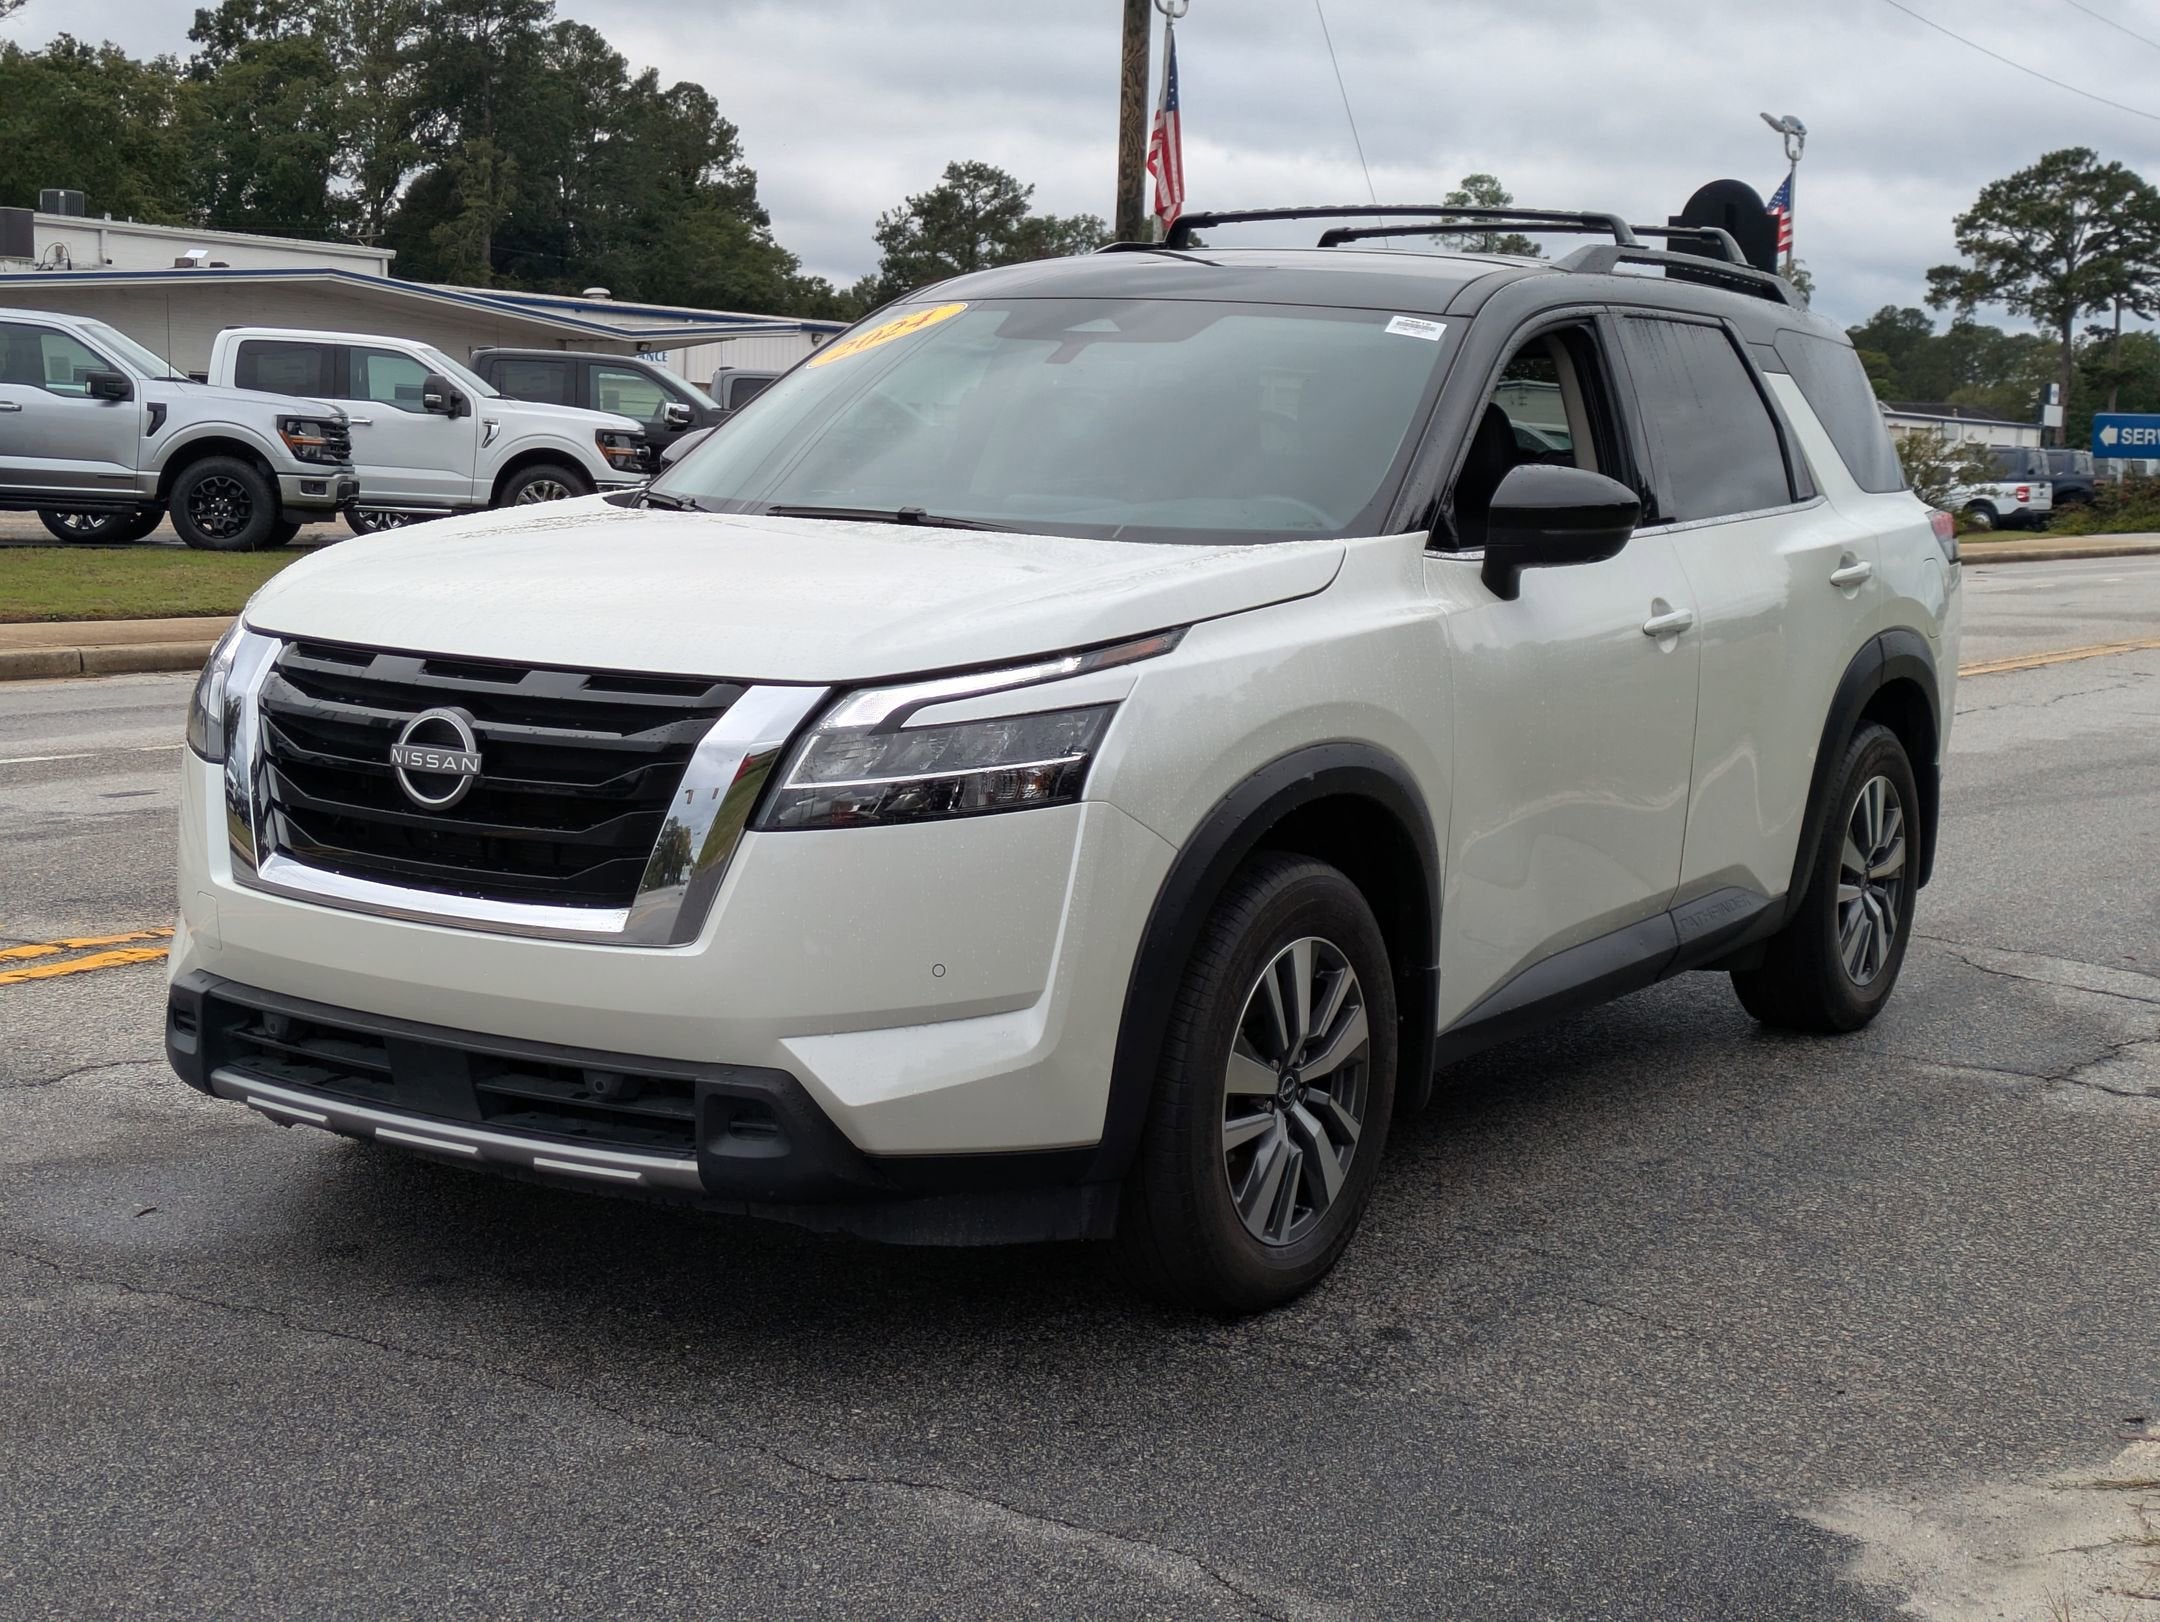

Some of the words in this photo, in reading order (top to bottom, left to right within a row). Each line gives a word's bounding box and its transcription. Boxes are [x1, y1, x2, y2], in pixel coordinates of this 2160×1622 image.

[827, 308, 939, 362] 2024
[2120, 427, 2160, 445] SER
[391, 748, 479, 772] NISSAN
